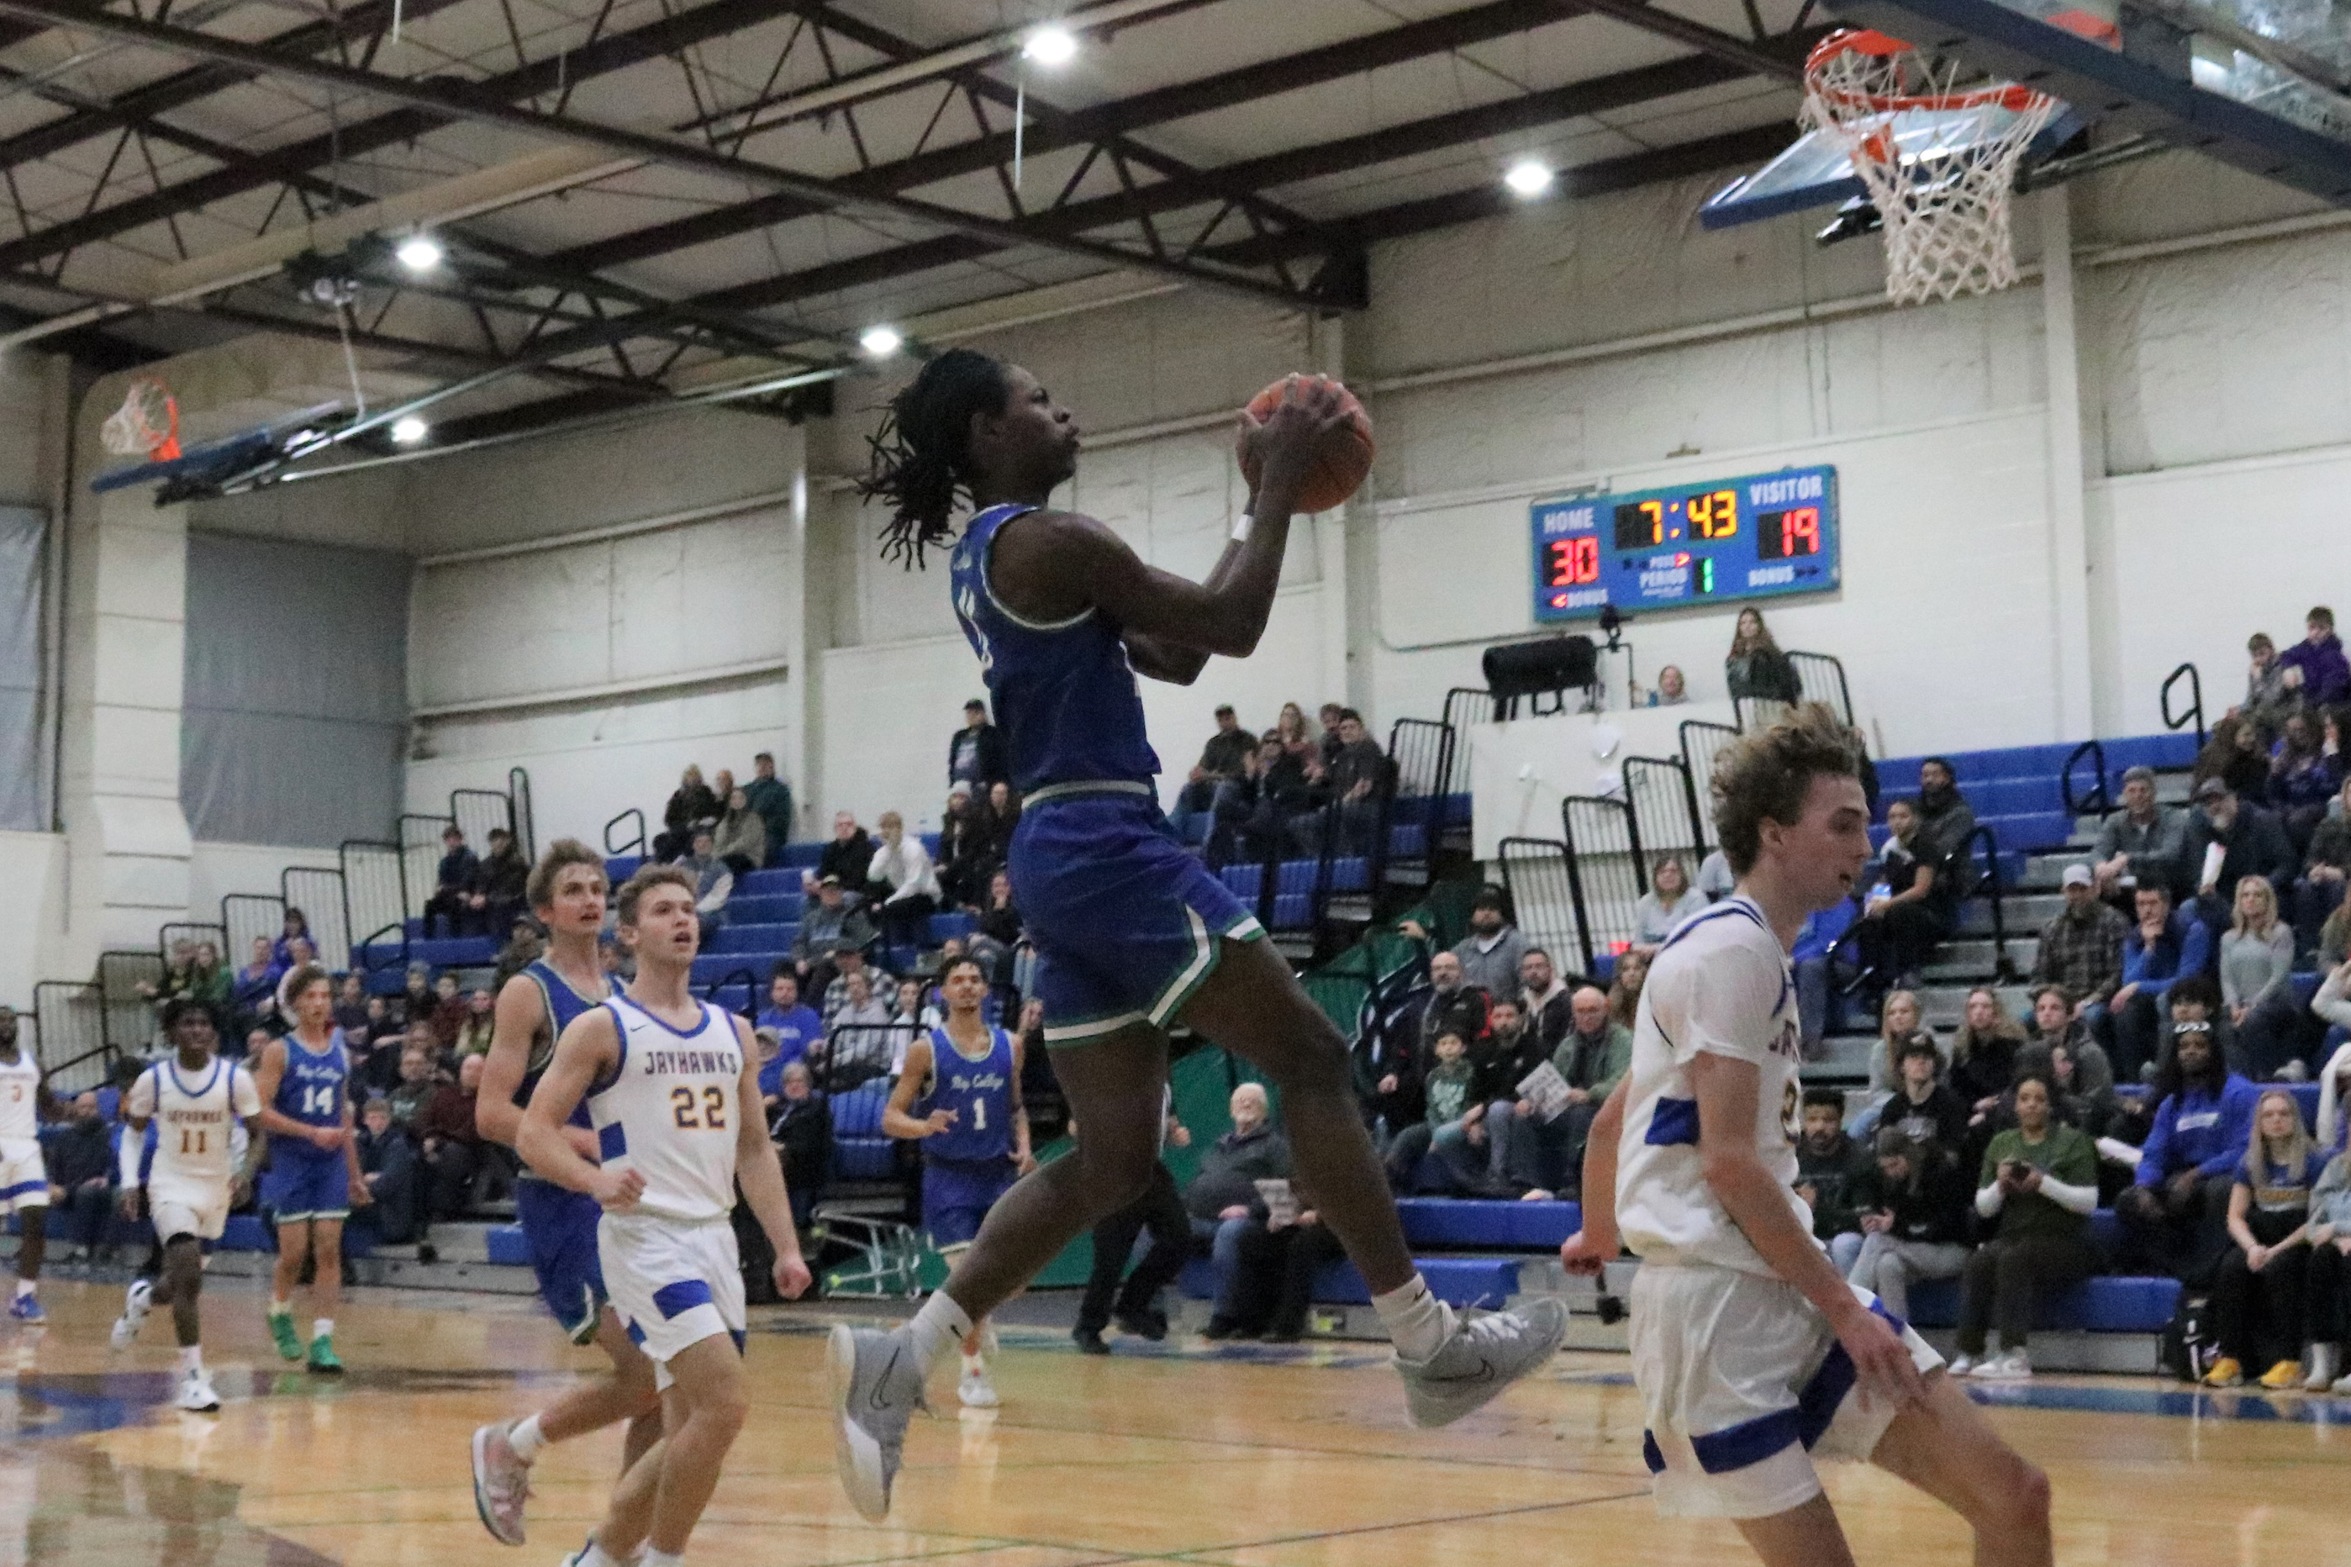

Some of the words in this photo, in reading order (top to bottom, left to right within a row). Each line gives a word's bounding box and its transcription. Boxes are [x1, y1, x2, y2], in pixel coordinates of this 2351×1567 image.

[1750, 474, 1823, 506] VISITOR
[1543, 507, 1595, 534] HOME
[1638, 489, 1738, 545] 7:43
[1781, 507, 1819, 556] 19
[1551, 535, 1599, 587] 30
[1702, 556, 1714, 594] 1
[1747, 564, 1795, 588] BONUS
[1639, 566, 1689, 590] PERIOD
[644, 1050, 738, 1075] JAYHAWKS
[302, 1084, 333, 1115] 14
[671, 1085, 725, 1129] 22
[973, 1097, 986, 1130] 1
[181, 1129, 206, 1153] 11
